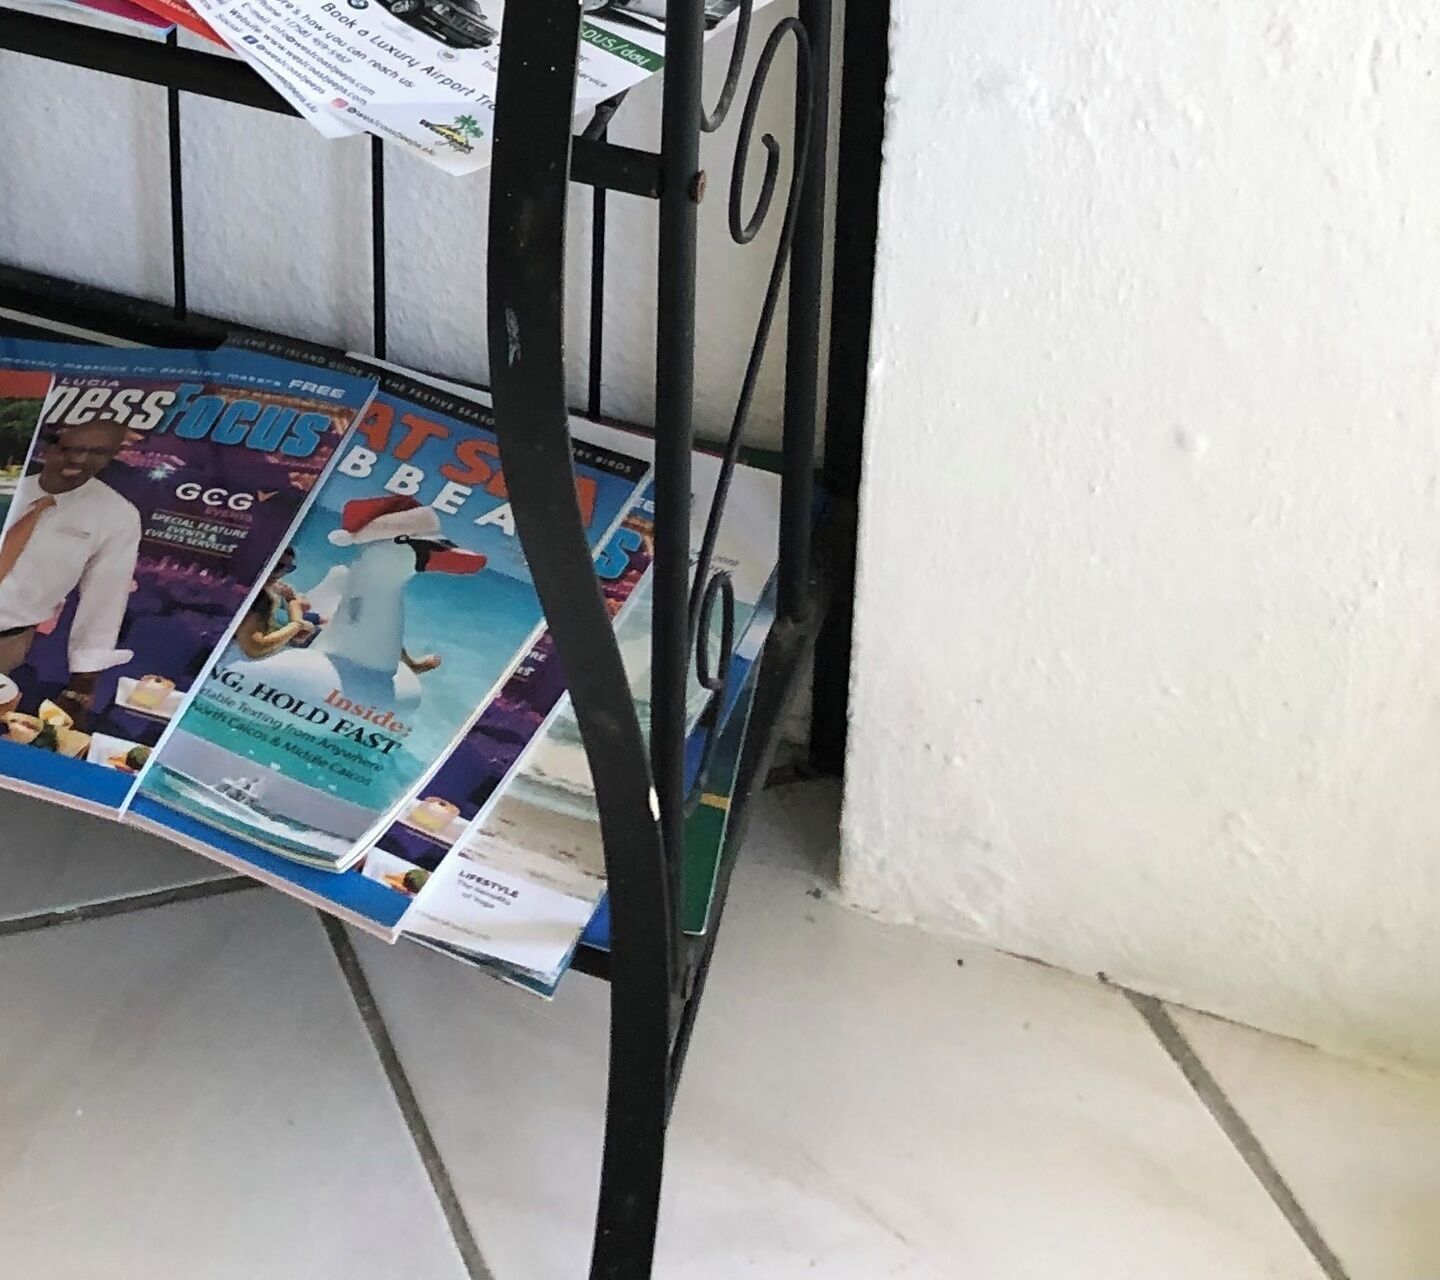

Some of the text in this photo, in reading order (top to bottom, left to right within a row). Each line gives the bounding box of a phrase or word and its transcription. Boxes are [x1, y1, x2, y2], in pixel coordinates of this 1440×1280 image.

[301, 12, 325, 33] how
[324, 29, 348, 50] you
[346, 41, 368, 62] can
[367, 54, 399, 79] reach
[320, 1, 358, 30] Book
[357, 27, 370, 38] a
[369, 33, 421, 70] Luxury
[419, 64, 477, 99] Airport
[474, 91, 496, 112] Tra
[60, 376, 121, 388] LUCIA
[286, 378, 348, 400] FREE
[360, 401, 450, 461] AT
[410, 388, 453, 411] FESTIVE
[458, 406, 496, 426] SEASO
[595, 451, 633, 474] BIRDS
[338, 444, 516, 537] BBEA
[144, 528, 185, 543] EVENTS
[150, 512, 249, 539] SPECIAL FEATURE
[209, 665, 403, 755] NG, HOLD FAST
[238, 698, 385, 773] Texting from Anywhere
[323, 687, 413, 739] Inside:
[227, 715, 269, 742] Caicos
[283, 742, 328, 768] Middle
[328, 760, 374, 788] Caicos
[458, 869, 520, 899] LIFESTYLE
